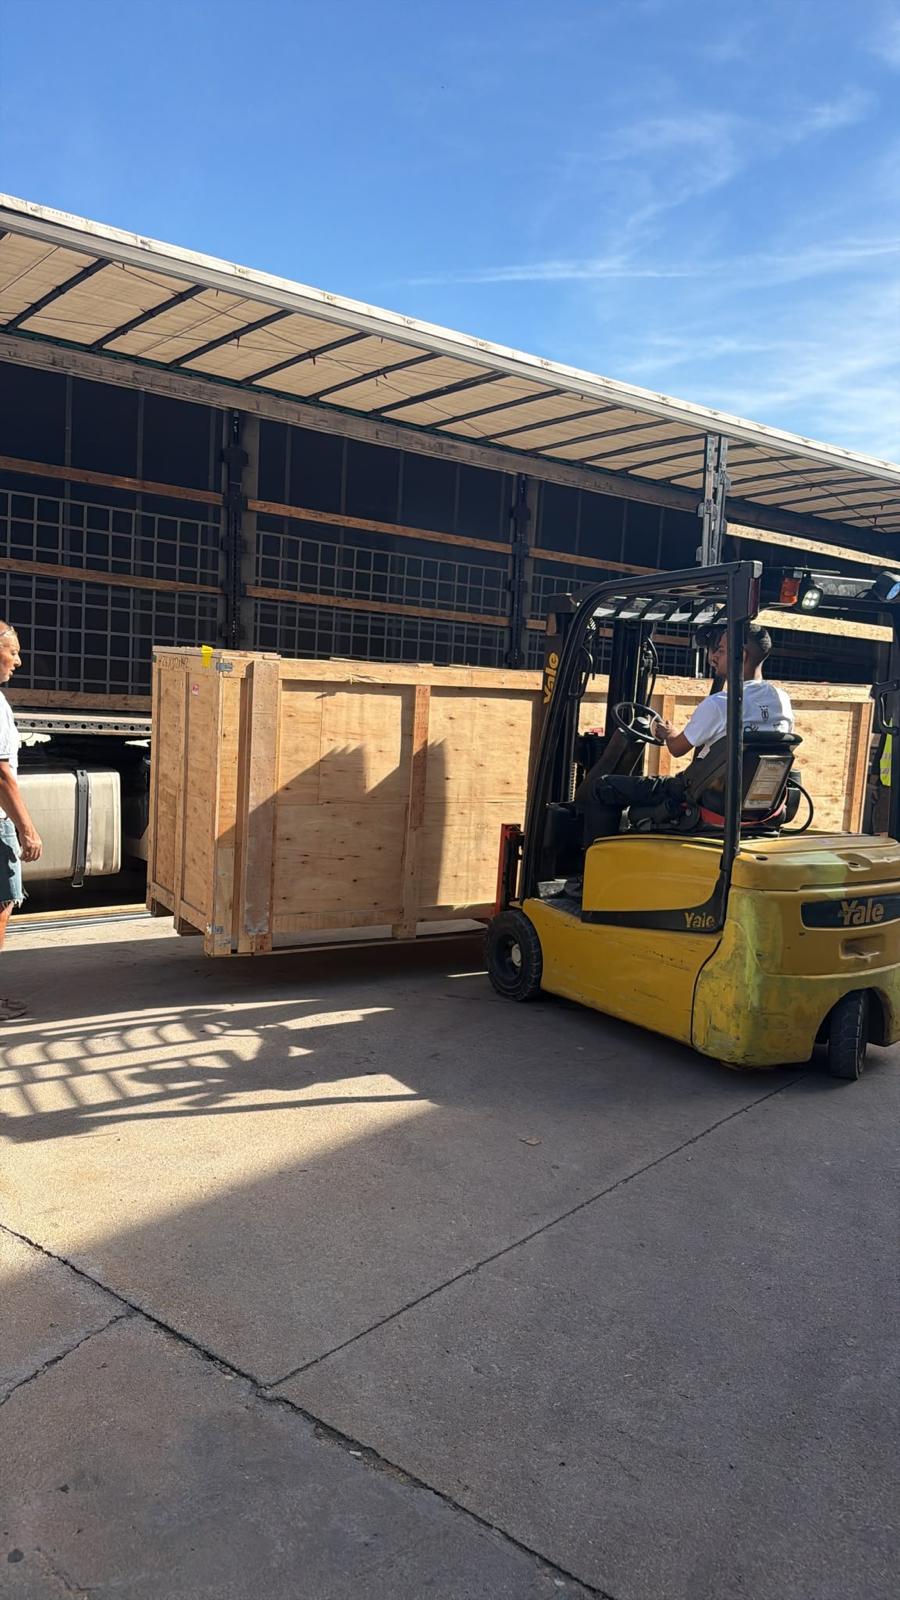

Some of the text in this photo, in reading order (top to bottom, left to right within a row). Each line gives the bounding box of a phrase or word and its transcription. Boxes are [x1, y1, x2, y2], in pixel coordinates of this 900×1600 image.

[543, 652, 559, 704] Yale
[683, 911, 716, 929] Yale
[841, 898, 885, 926] Yale
